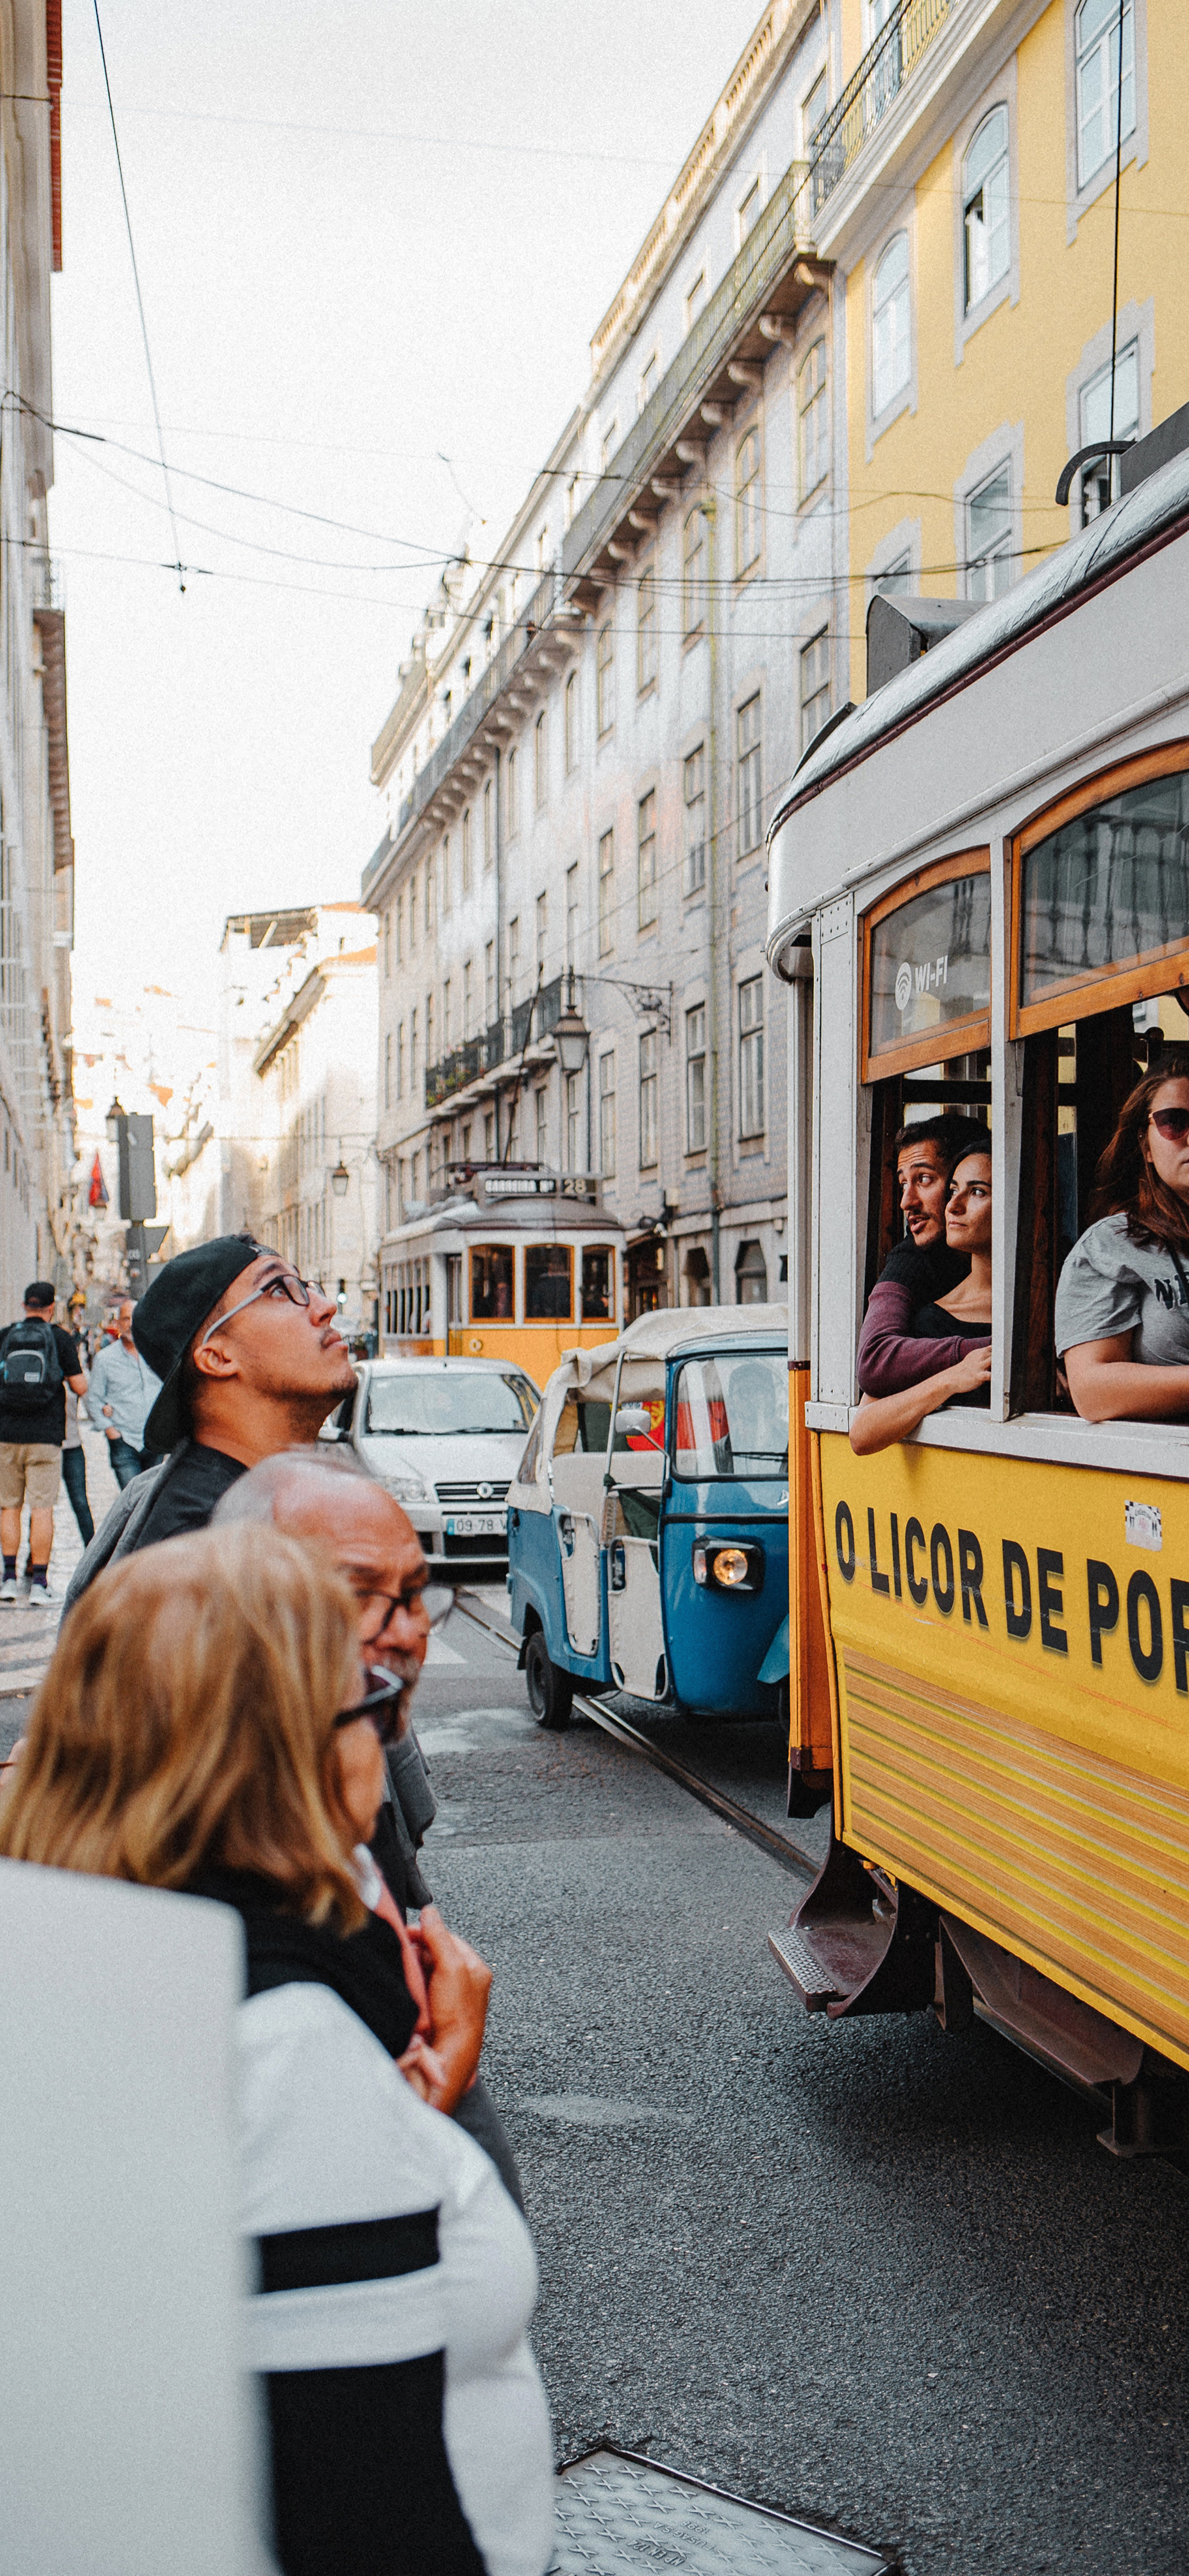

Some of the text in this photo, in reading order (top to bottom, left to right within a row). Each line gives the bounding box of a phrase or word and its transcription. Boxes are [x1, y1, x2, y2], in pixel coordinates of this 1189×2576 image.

[915, 955, 948, 994] WI-FI
[564, 1178, 587, 1194] 28
[456, 1520, 472, 1531] 09
[478, 1519, 493, 1531] 78
[835, 1500, 855, 1581] O
[867, 1507, 989, 1627] LICOR
[1002, 1539, 1068, 1653] DE
